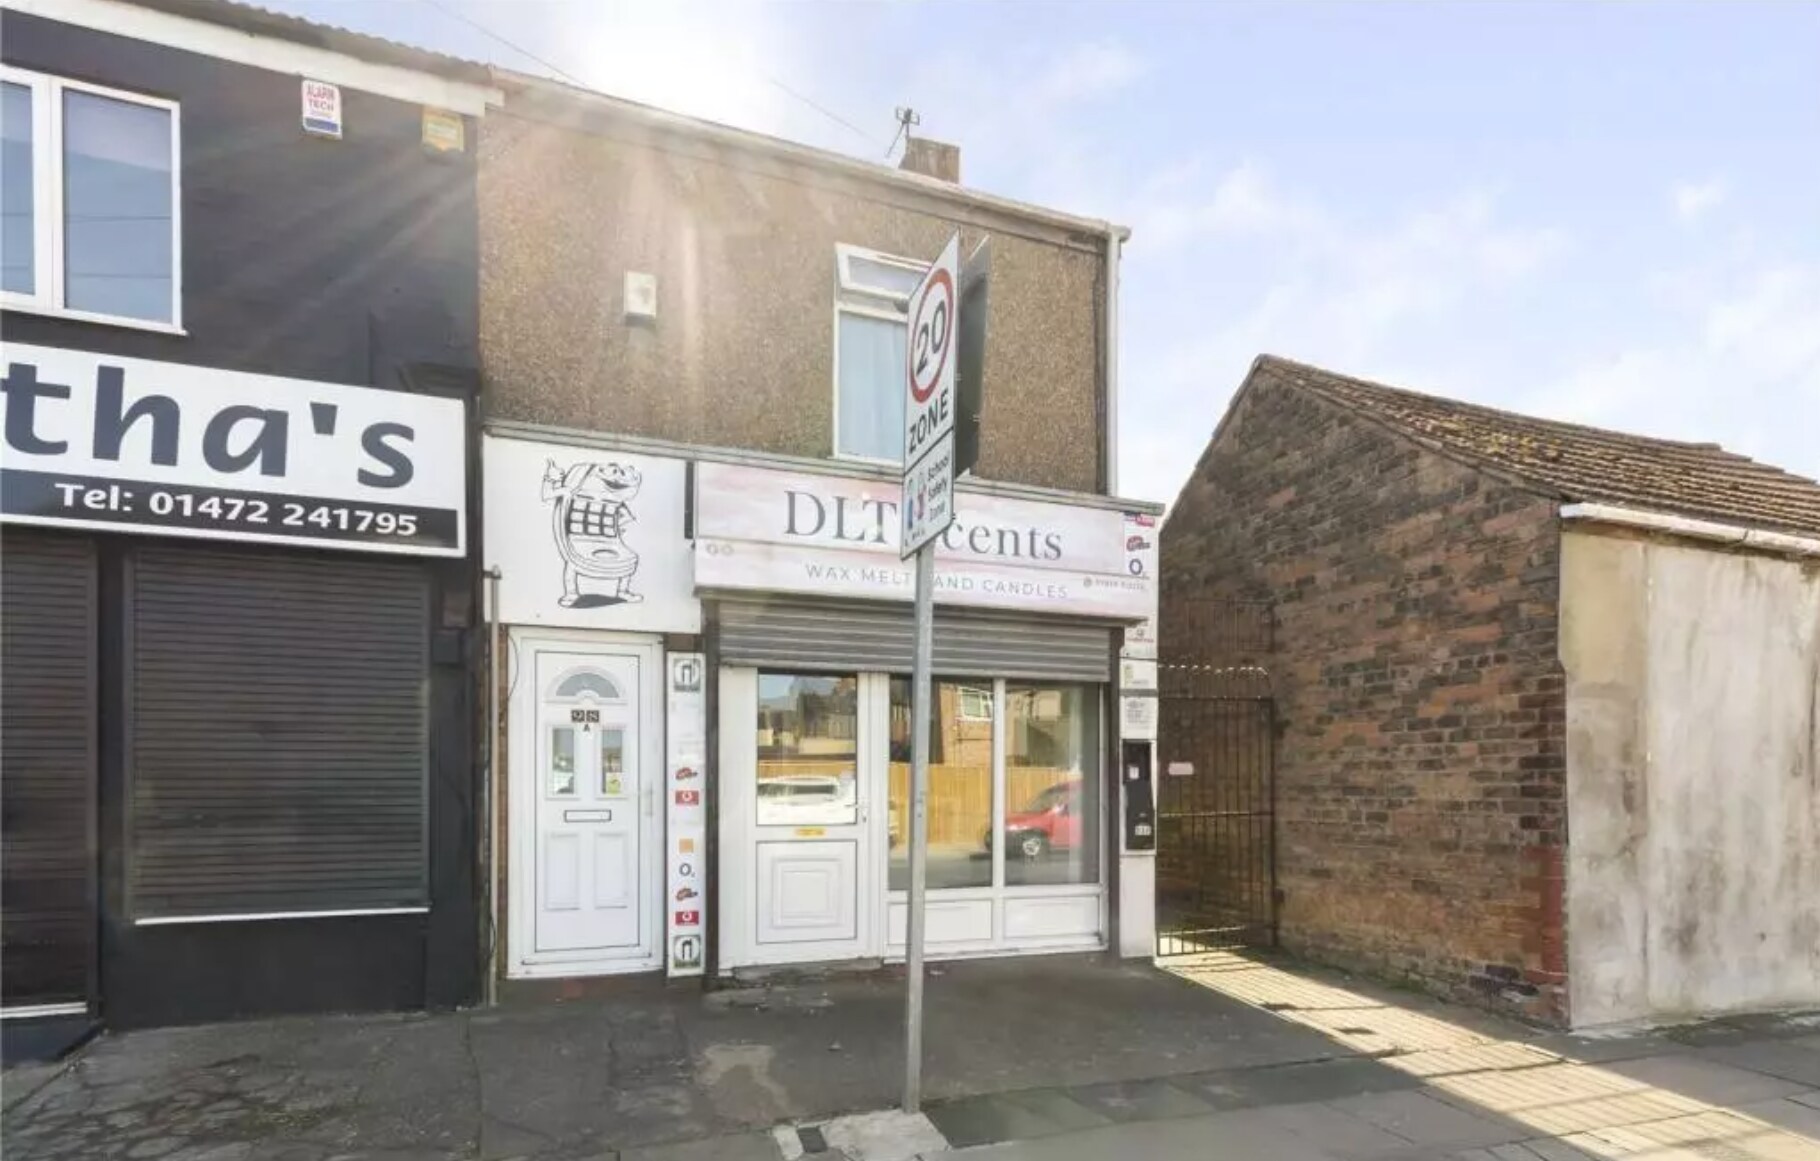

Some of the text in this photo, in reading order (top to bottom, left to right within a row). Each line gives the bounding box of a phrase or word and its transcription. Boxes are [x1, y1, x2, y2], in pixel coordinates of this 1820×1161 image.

[306, 83, 335, 99] ALARM
[308, 99, 335, 112] TECH
[916, 299, 946, 376] 20
[908, 388, 949, 454] ZONE
[54, 482, 418, 537] Tel: 01472 241795
[784, 490, 898, 544] DLT
[942, 524, 1062, 561] cents
[805, 563, 1069, 599] WAX MELT AND CANDLES
